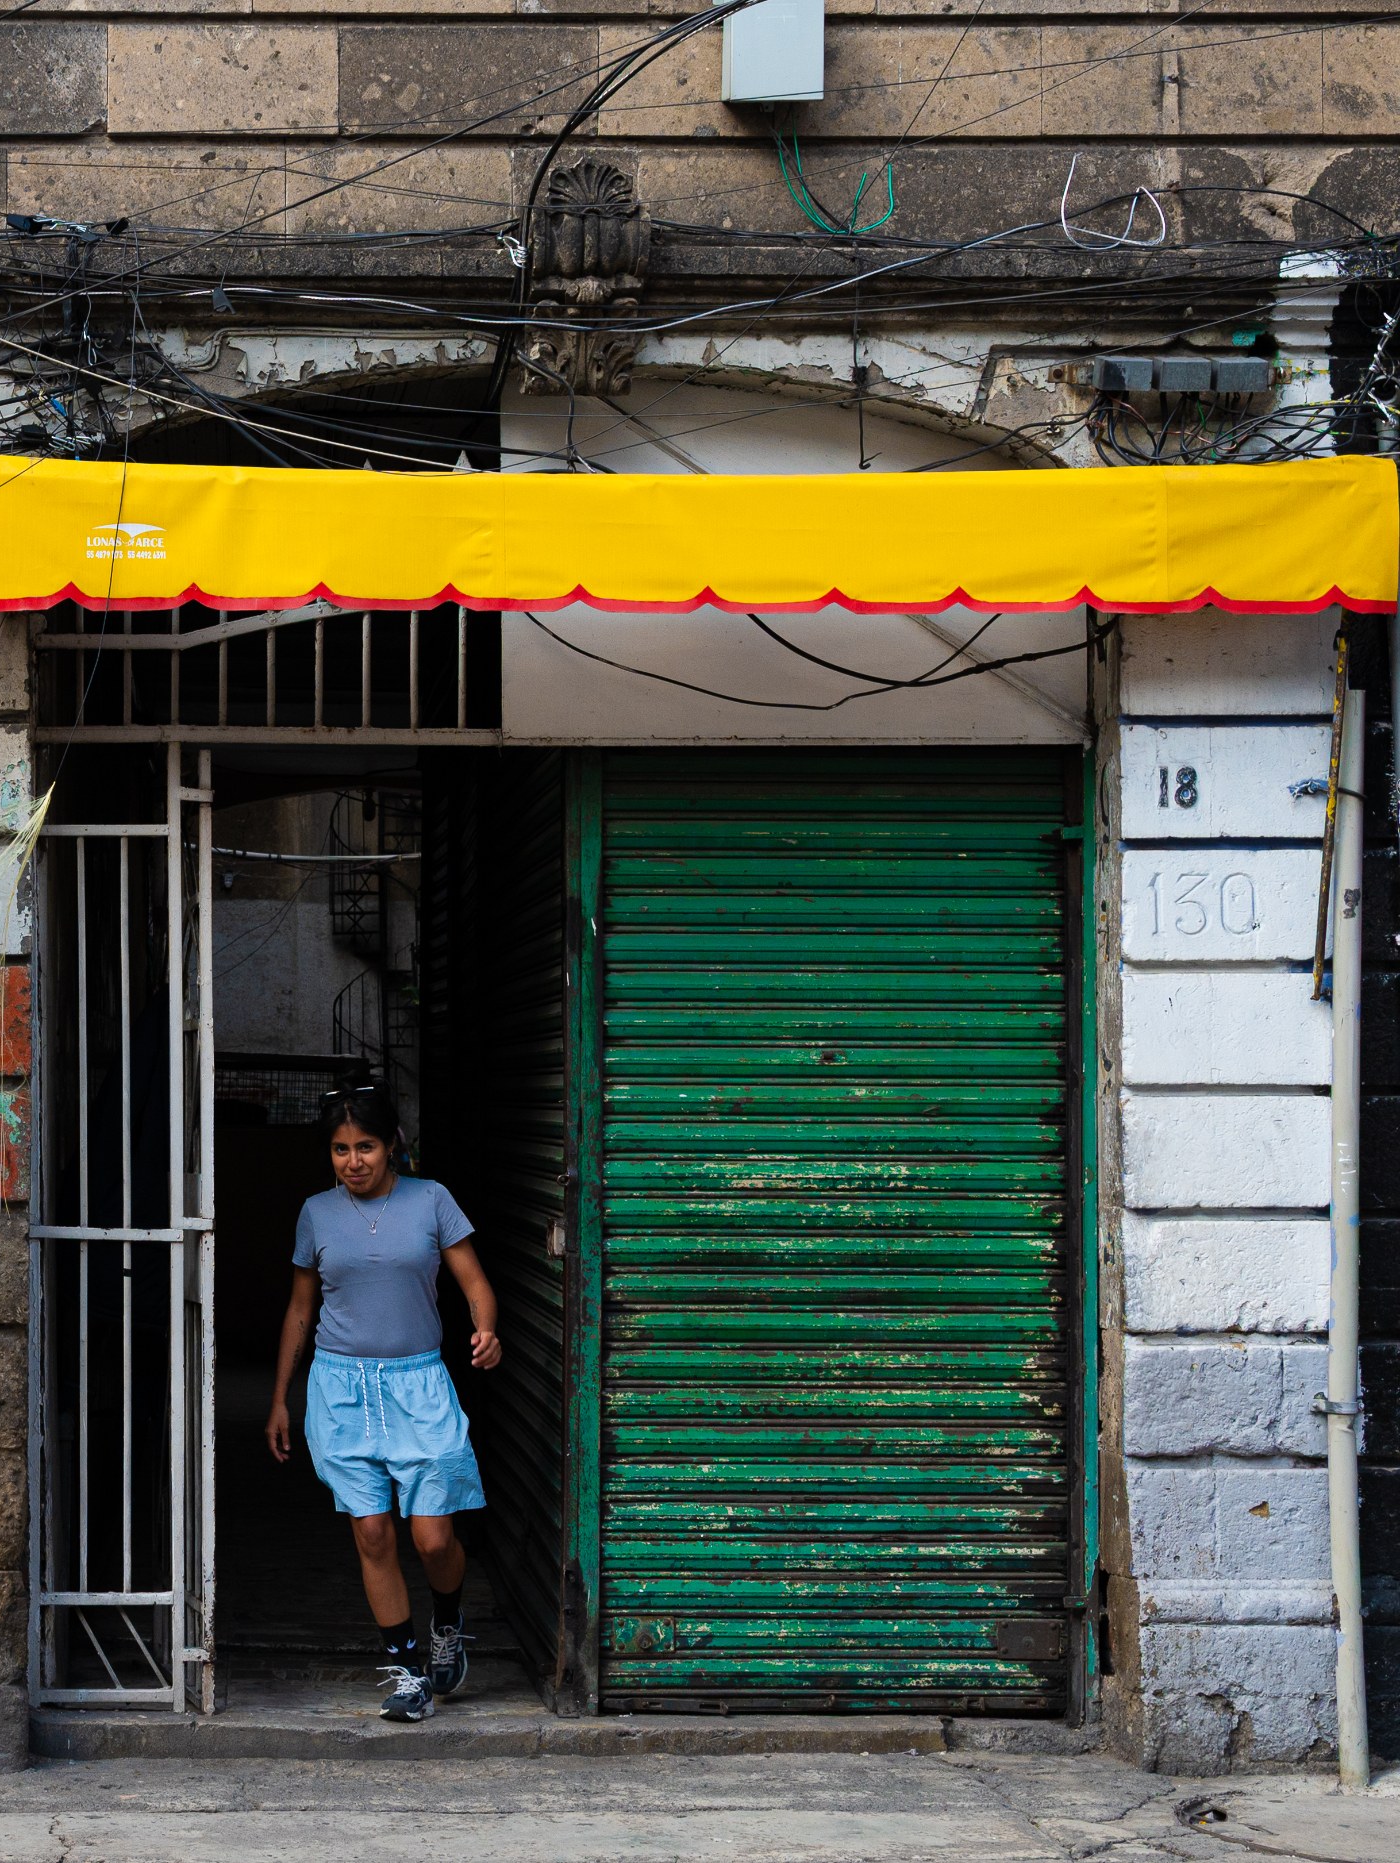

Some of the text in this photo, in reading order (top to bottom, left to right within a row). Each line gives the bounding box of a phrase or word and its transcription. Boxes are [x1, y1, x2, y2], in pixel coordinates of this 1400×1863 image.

[86, 536, 122, 547] LONAS
[136, 537, 164, 548] ARCE
[1157, 766, 1198, 809] 18
[1147, 871, 1256, 936] 130
